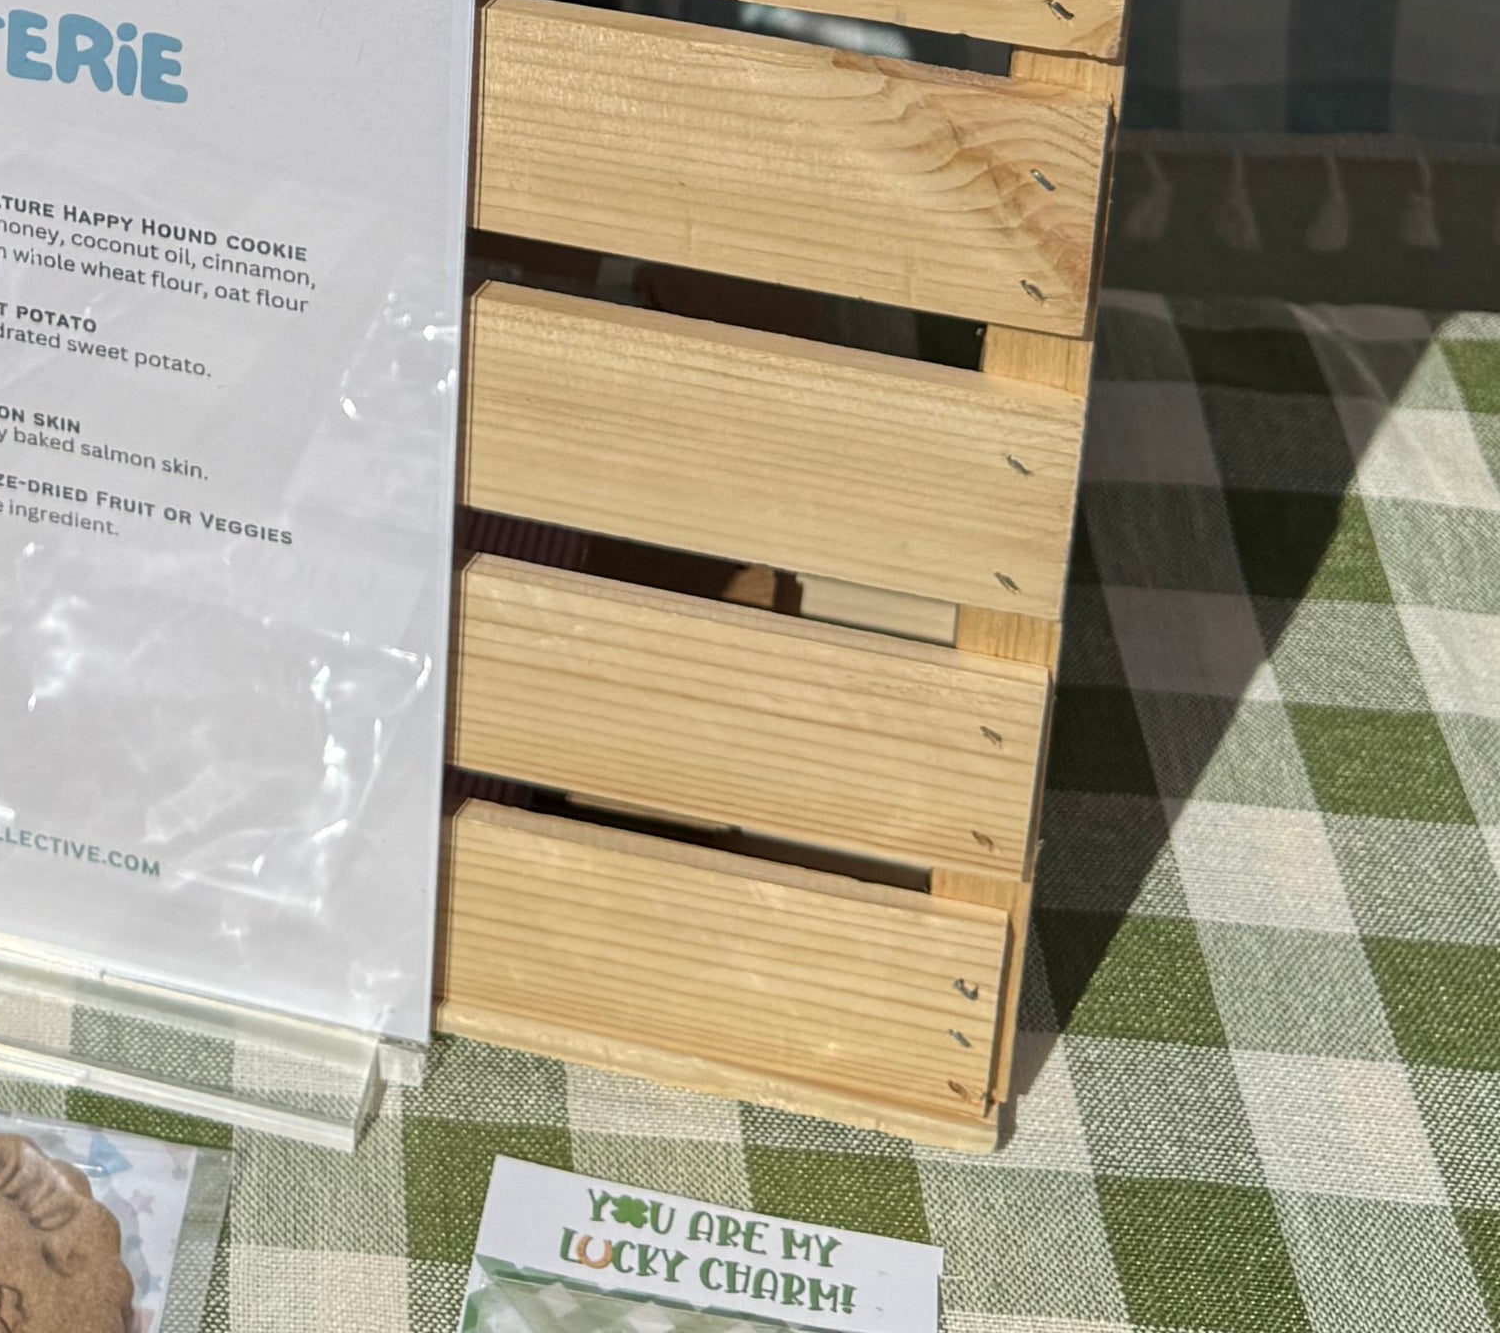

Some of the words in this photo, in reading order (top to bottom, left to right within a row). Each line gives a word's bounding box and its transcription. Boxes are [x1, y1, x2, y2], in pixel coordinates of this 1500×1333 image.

[63, 203, 134, 233] HAPPY
[141, 217, 218, 247] HOUND
[225, 234, 308, 263] COOKIE
[12, 246, 76, 273] whole
[80, 260, 147, 286] wheat
[150, 269, 209, 300] flour,
[214, 285, 251, 304] oat
[255, 287, 310, 314] flour
[70, 232, 160, 262] coconut
[164, 246, 197, 271] oil,
[201, 252, 316, 291] cinnamon,
[15, 304, 98, 335] POTATO
[66, 338, 130, 363] sweet
[134, 351, 212, 378] potato.
[32, 412, 81, 435] SKIN
[13, 425, 75, 454] baked
[80, 442, 156, 471] salmon
[161, 457, 209, 481] skin.
[8, 498, 120, 537] ingredient.
[96, 490, 157, 518] FRUIT
[163, 506, 192, 526] OR
[199, 510, 293, 546] VEGGIES
[686, 1209, 770, 1256] ARE
[780, 1226, 843, 1268] MY
[559, 1226, 690, 1283] LUCKY
[698, 1256, 858, 1315] CHARM!
